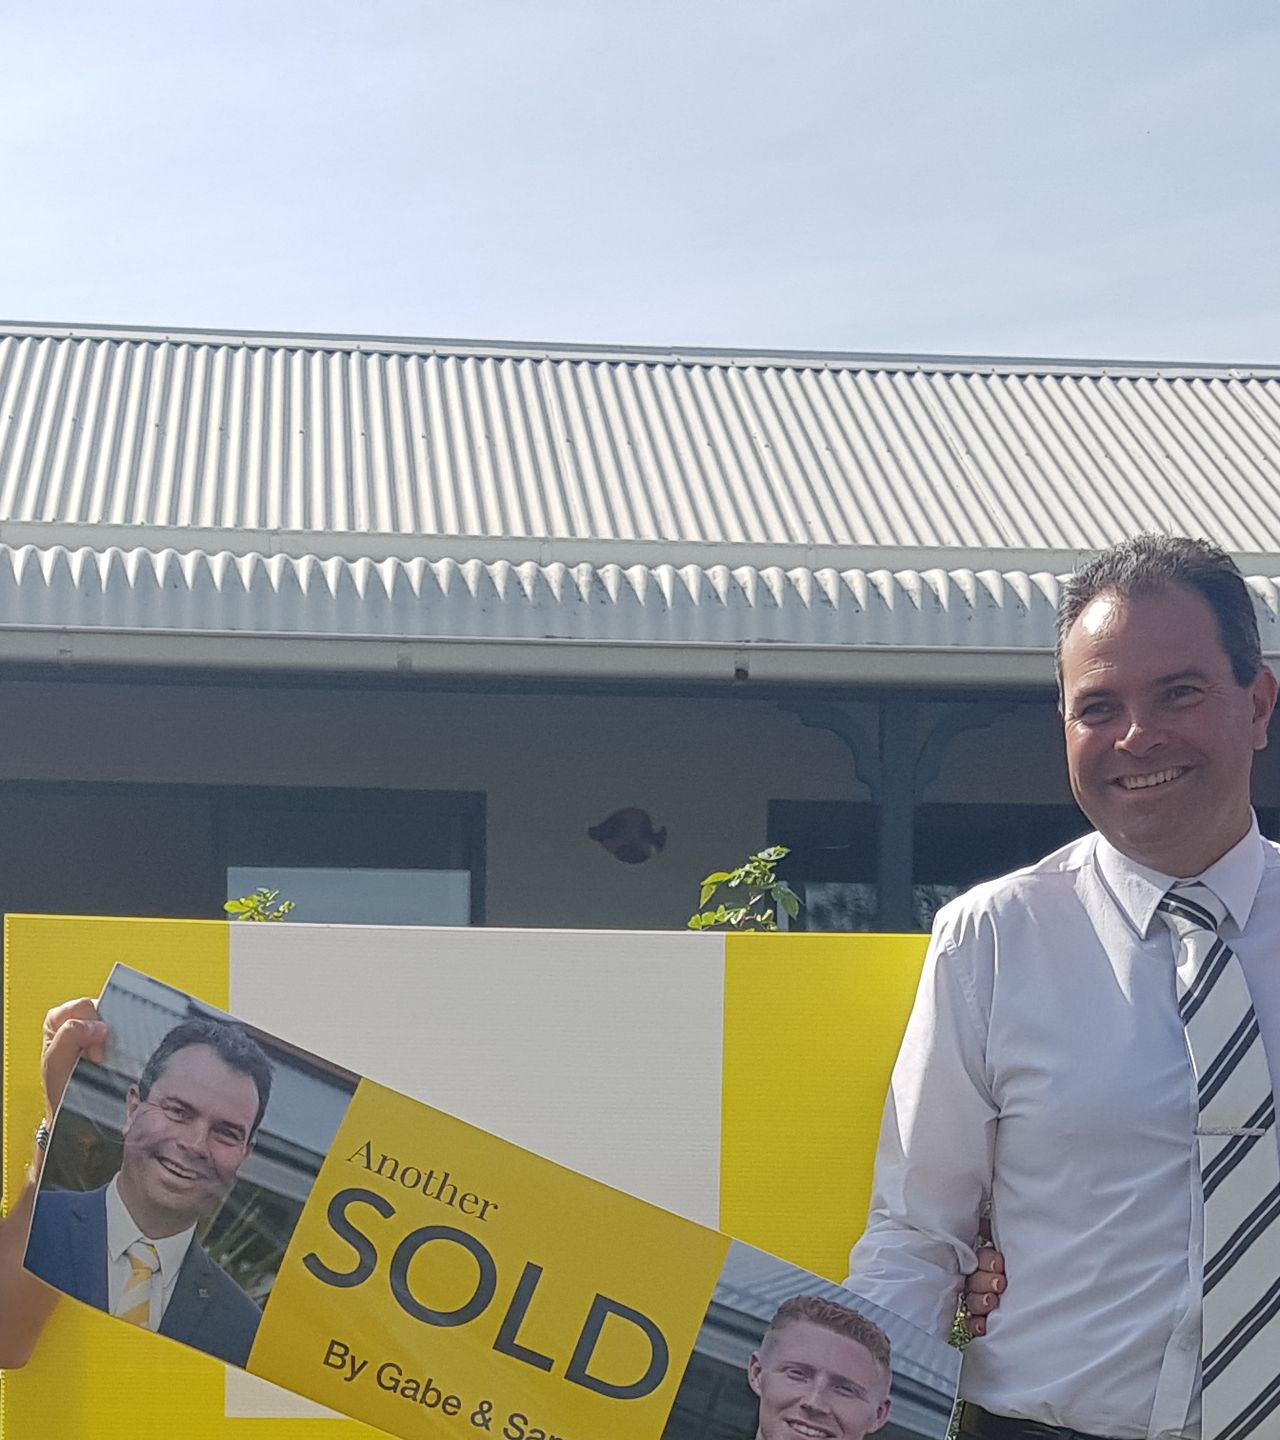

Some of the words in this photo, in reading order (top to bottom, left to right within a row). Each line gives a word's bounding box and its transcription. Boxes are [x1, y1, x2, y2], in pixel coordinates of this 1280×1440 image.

[346, 1139, 499, 1223] Another
[302, 1187, 670, 1400] SOLD
[322, 1339, 369, 1382] By
[375, 1362, 463, 1417] Gabe
[470, 1400, 493, 1431] &
